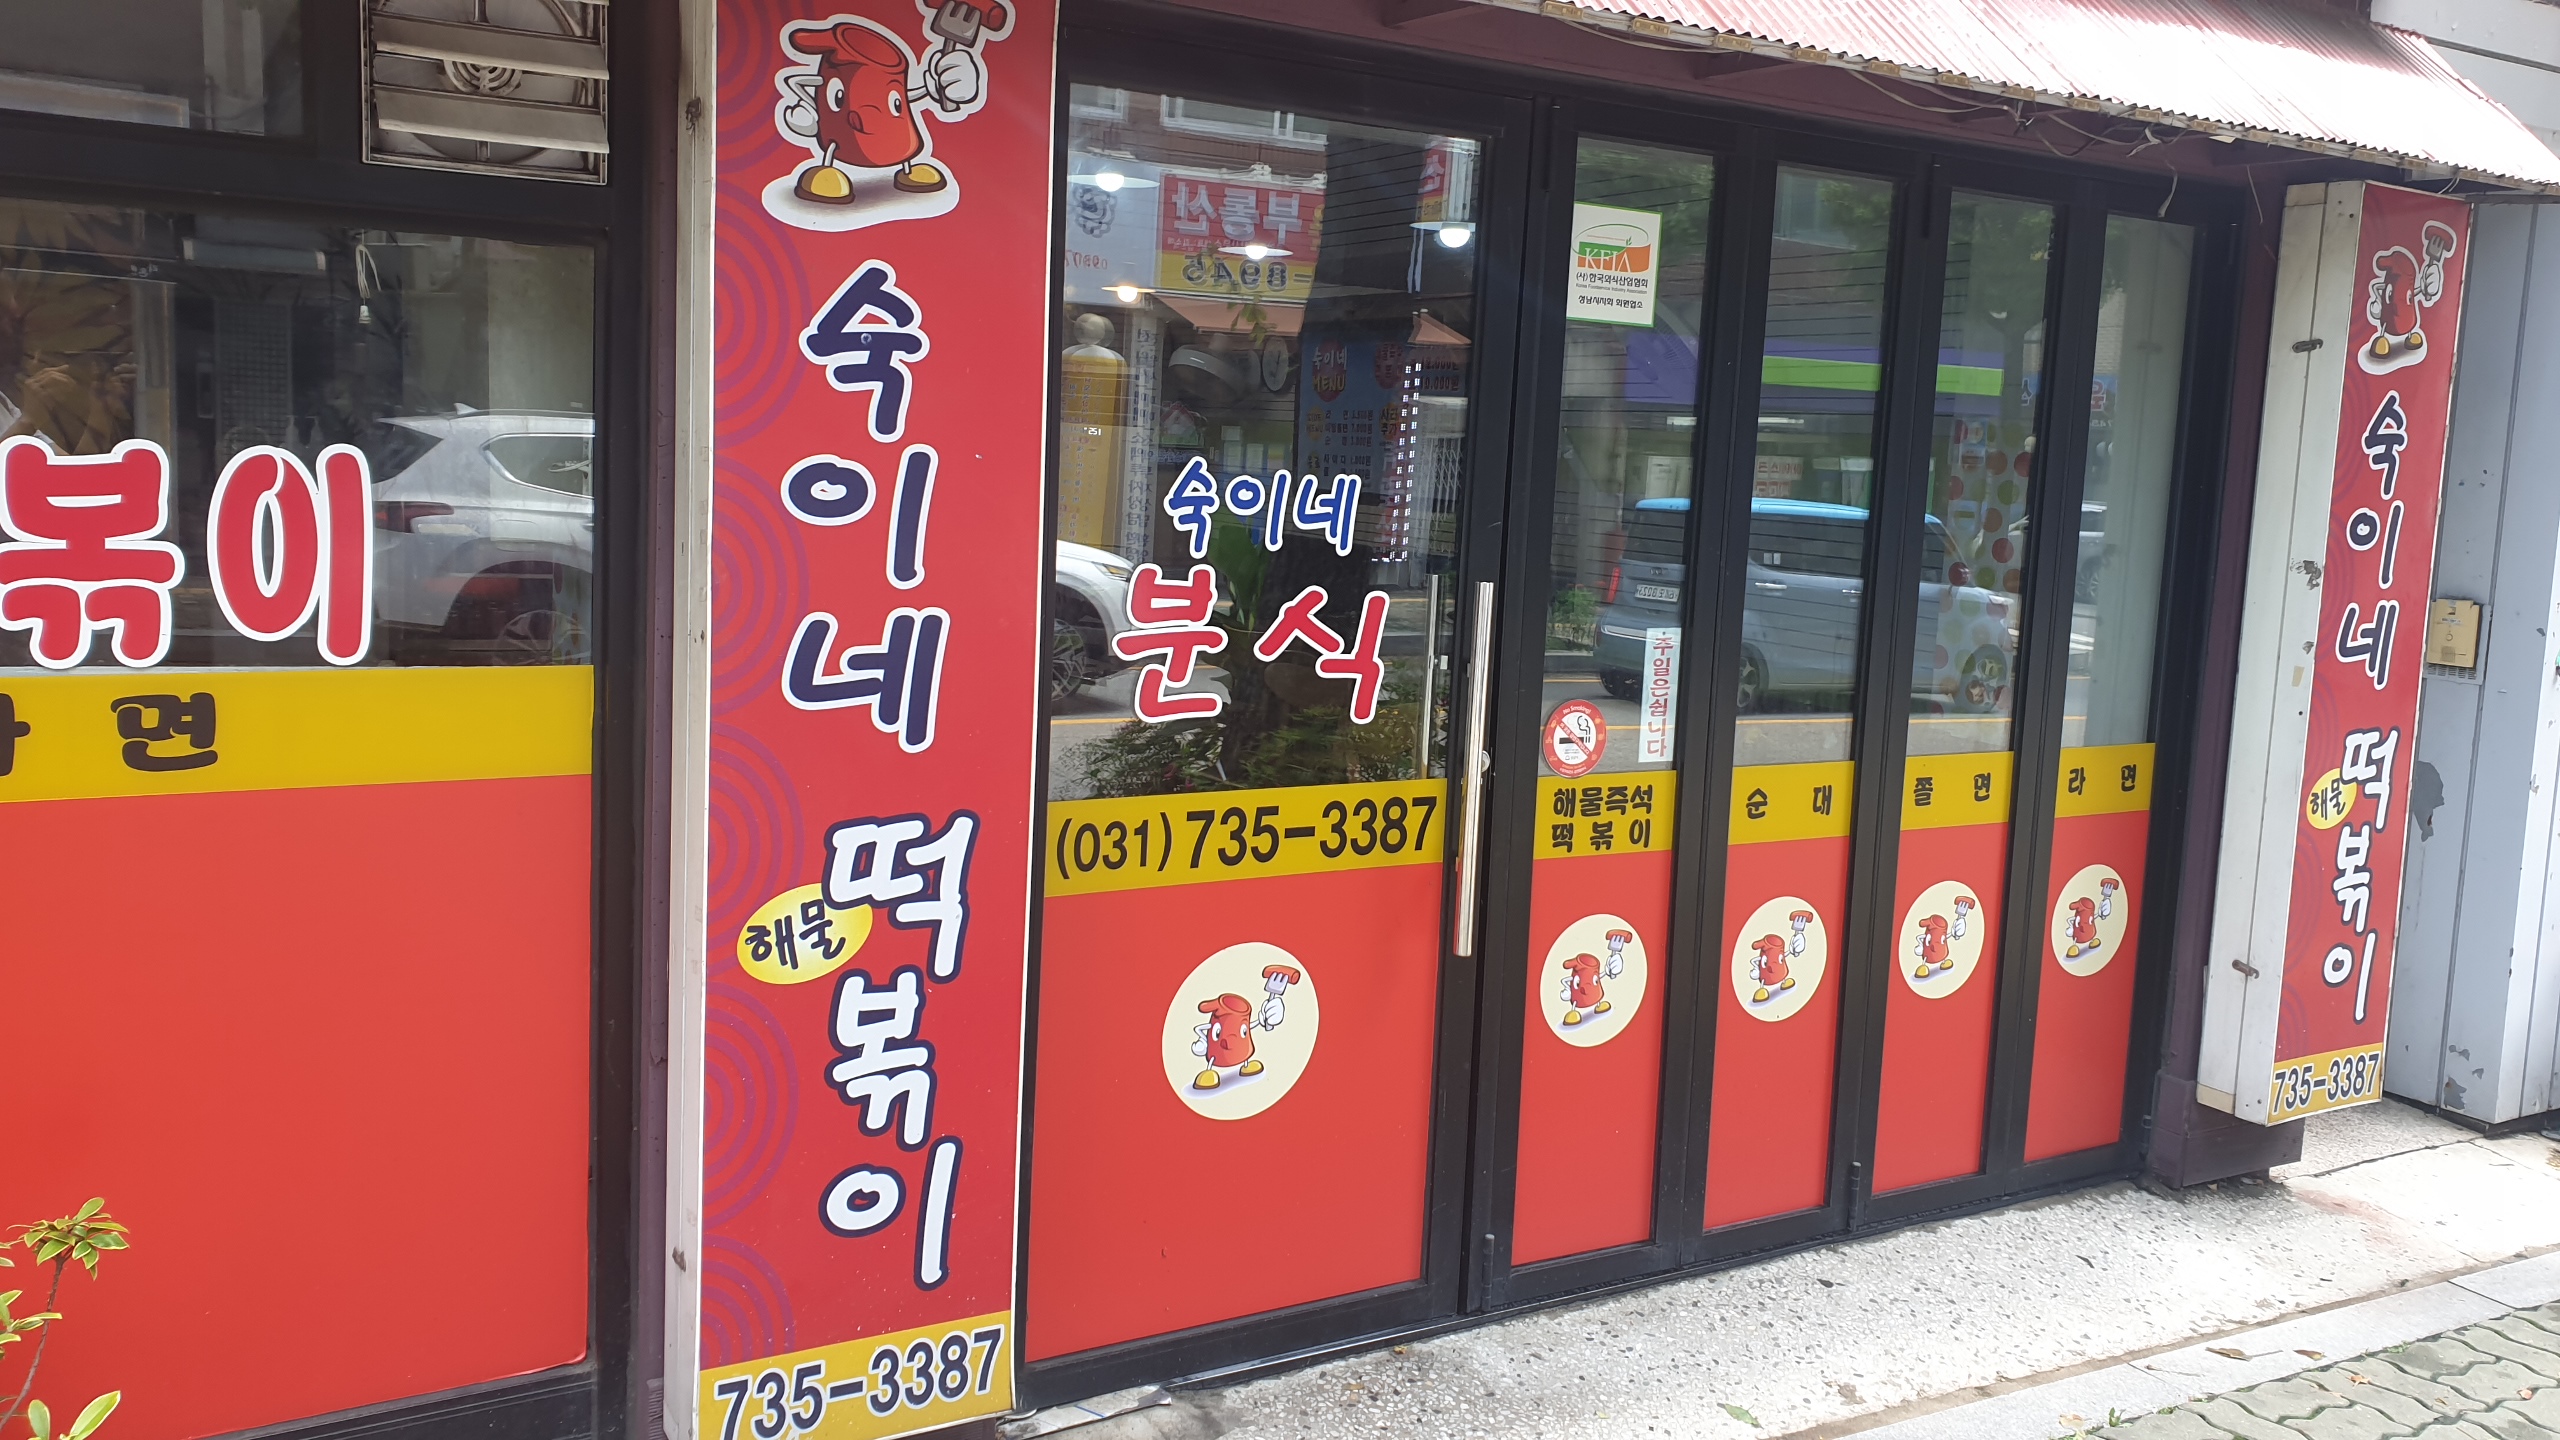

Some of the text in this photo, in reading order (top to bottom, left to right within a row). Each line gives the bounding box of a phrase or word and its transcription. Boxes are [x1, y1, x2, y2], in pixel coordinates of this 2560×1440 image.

[780, 258, 951, 754] 숙이네
[1163, 455, 1362, 559] 숙이네
[2336, 390, 2408, 690] 숙이네
[1111, 563, 1391, 725] 분식
[1553, 784, 1654, 818] 해물즉석
[1745, 784, 1832, 820] 순대
[1913, 772, 1991, 807] 쫄면
[2068, 763, 2137, 796] 라면
[2309, 777, 2347, 822] 해물
[1056, 795, 1438, 880] (031) 735-3387
[1551, 818, 1651, 853] 떡볶이
[2322, 725, 2400, 1023] 떡볶이
[744, 899, 848, 970] 해물
[818, 808, 981, 1292] 떡볶이
[2271, 1050, 2380, 1117] 735-3387
[713, 1323, 1005, 1440] 735-3387
